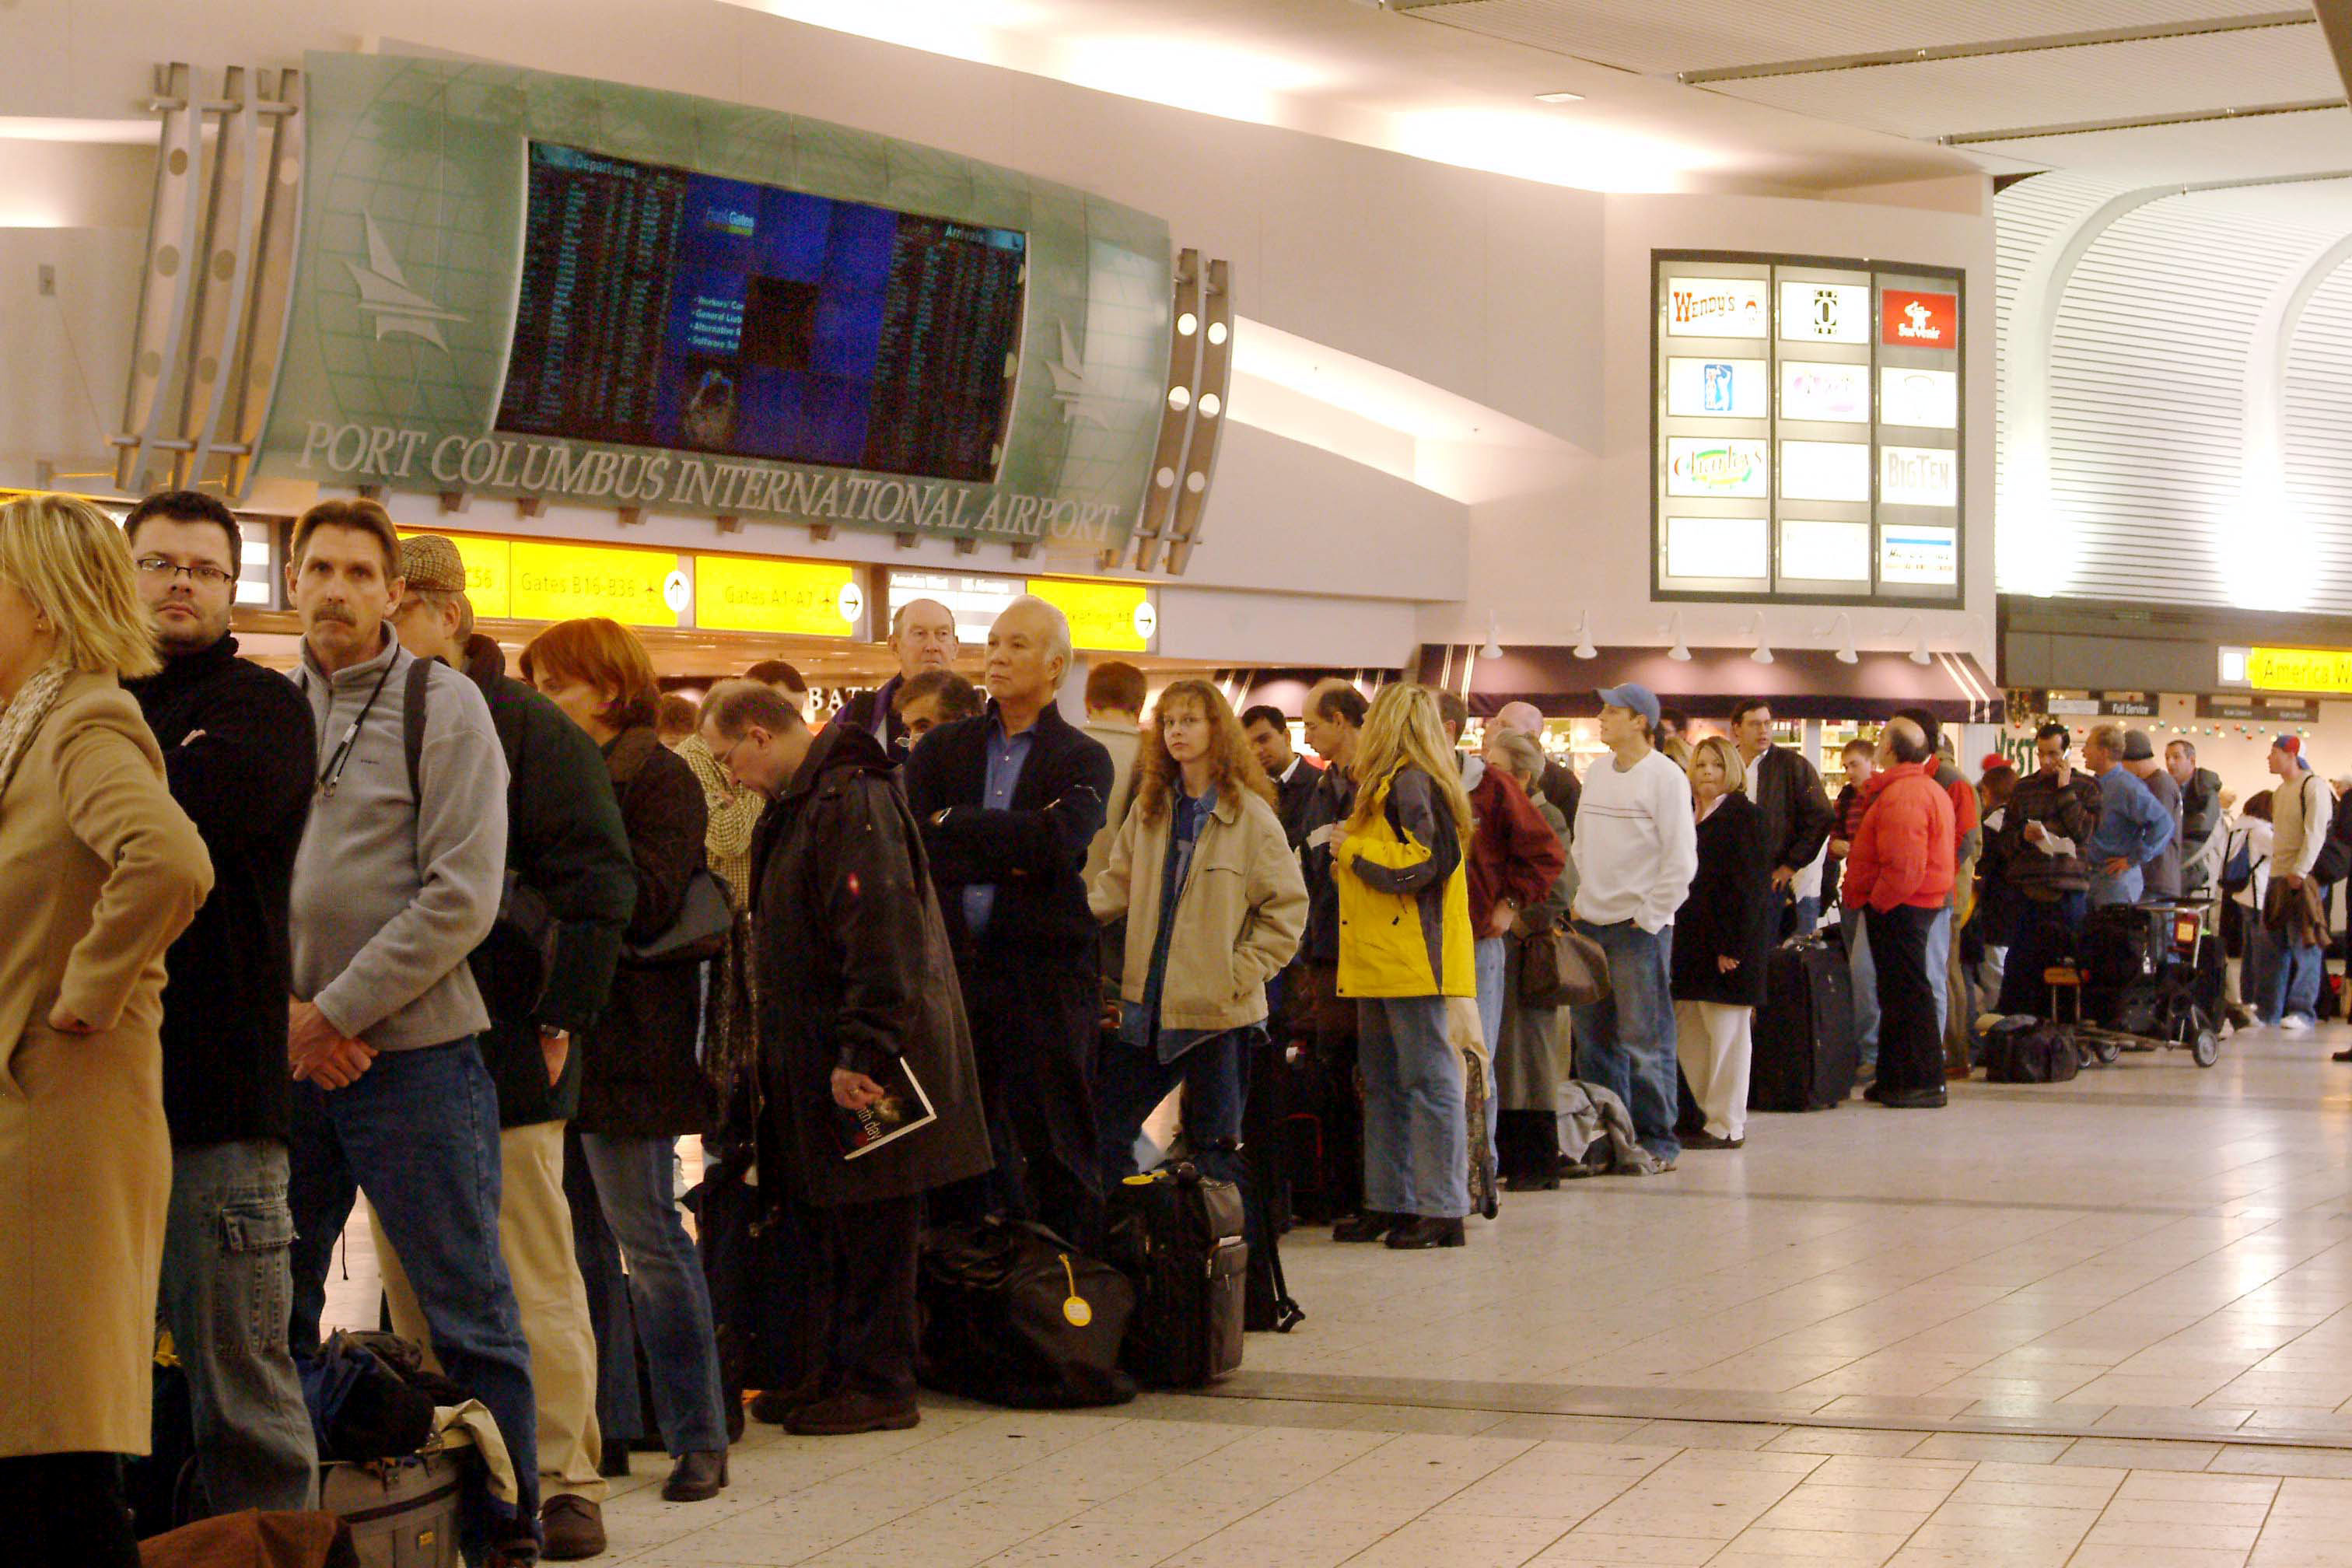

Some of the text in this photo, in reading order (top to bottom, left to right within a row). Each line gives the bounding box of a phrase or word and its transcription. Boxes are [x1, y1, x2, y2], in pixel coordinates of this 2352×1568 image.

[575, 156, 635, 178] Departures
[695, 308, 725, 320] General
[694, 322, 734, 335] Alternative
[295, 422, 1120, 540] PORT COLUMBUS INTERNATIONAL AIRPORT
[521, 572, 567, 594] Gates
[725, 586, 765, 606] Gates
[2263, 659, 2329, 684] America
[808, 686, 882, 713] BAT
[2112, 702, 2149, 715] Full Service
